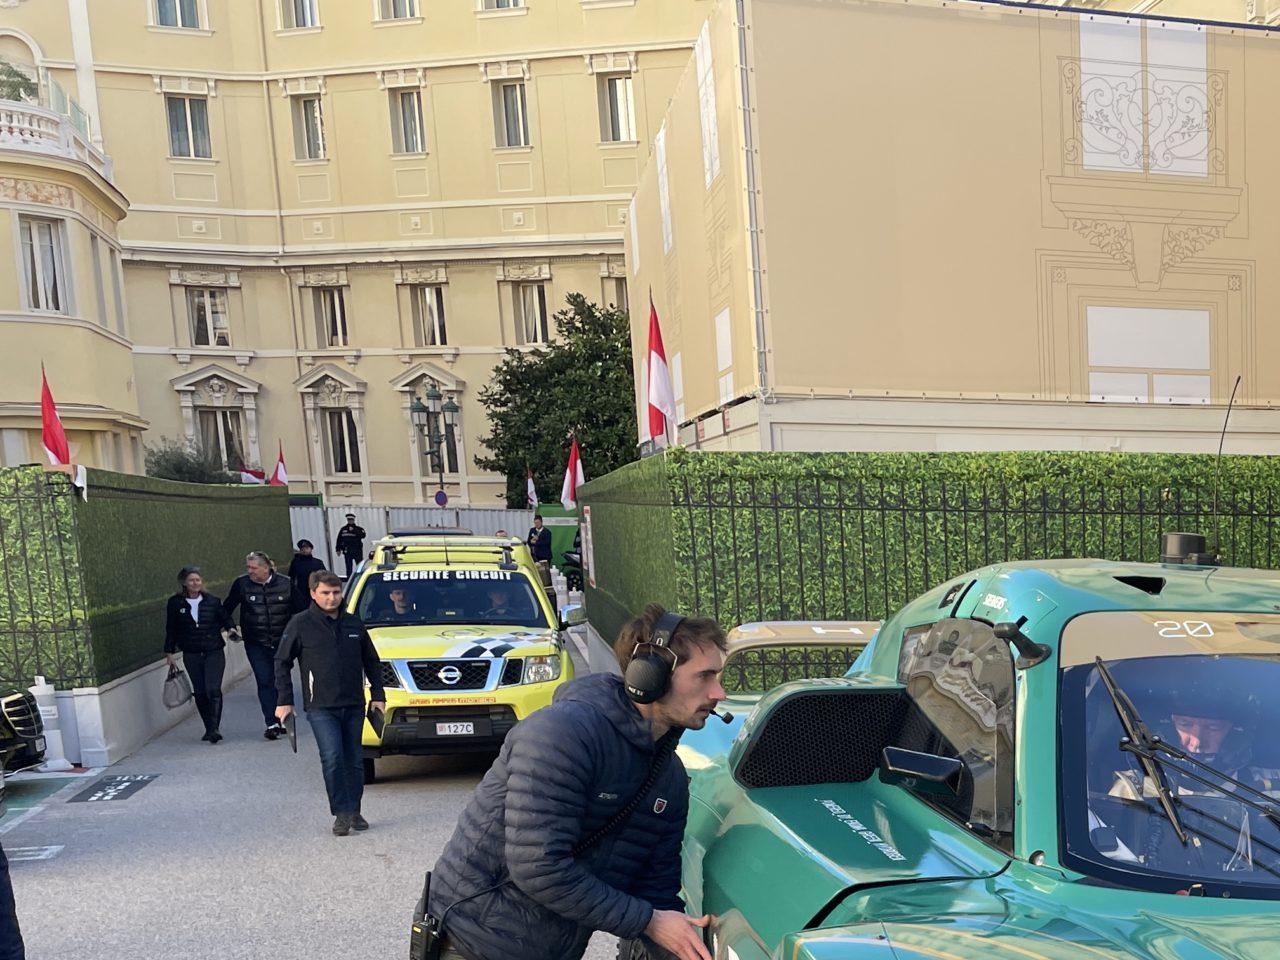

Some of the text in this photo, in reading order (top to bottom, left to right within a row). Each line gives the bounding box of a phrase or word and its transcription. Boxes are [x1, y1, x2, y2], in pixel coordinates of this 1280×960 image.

[455, 570, 512, 580] CIRCUIT
[1153, 620, 1215, 638] 20
[447, 724, 473, 734] 127C
